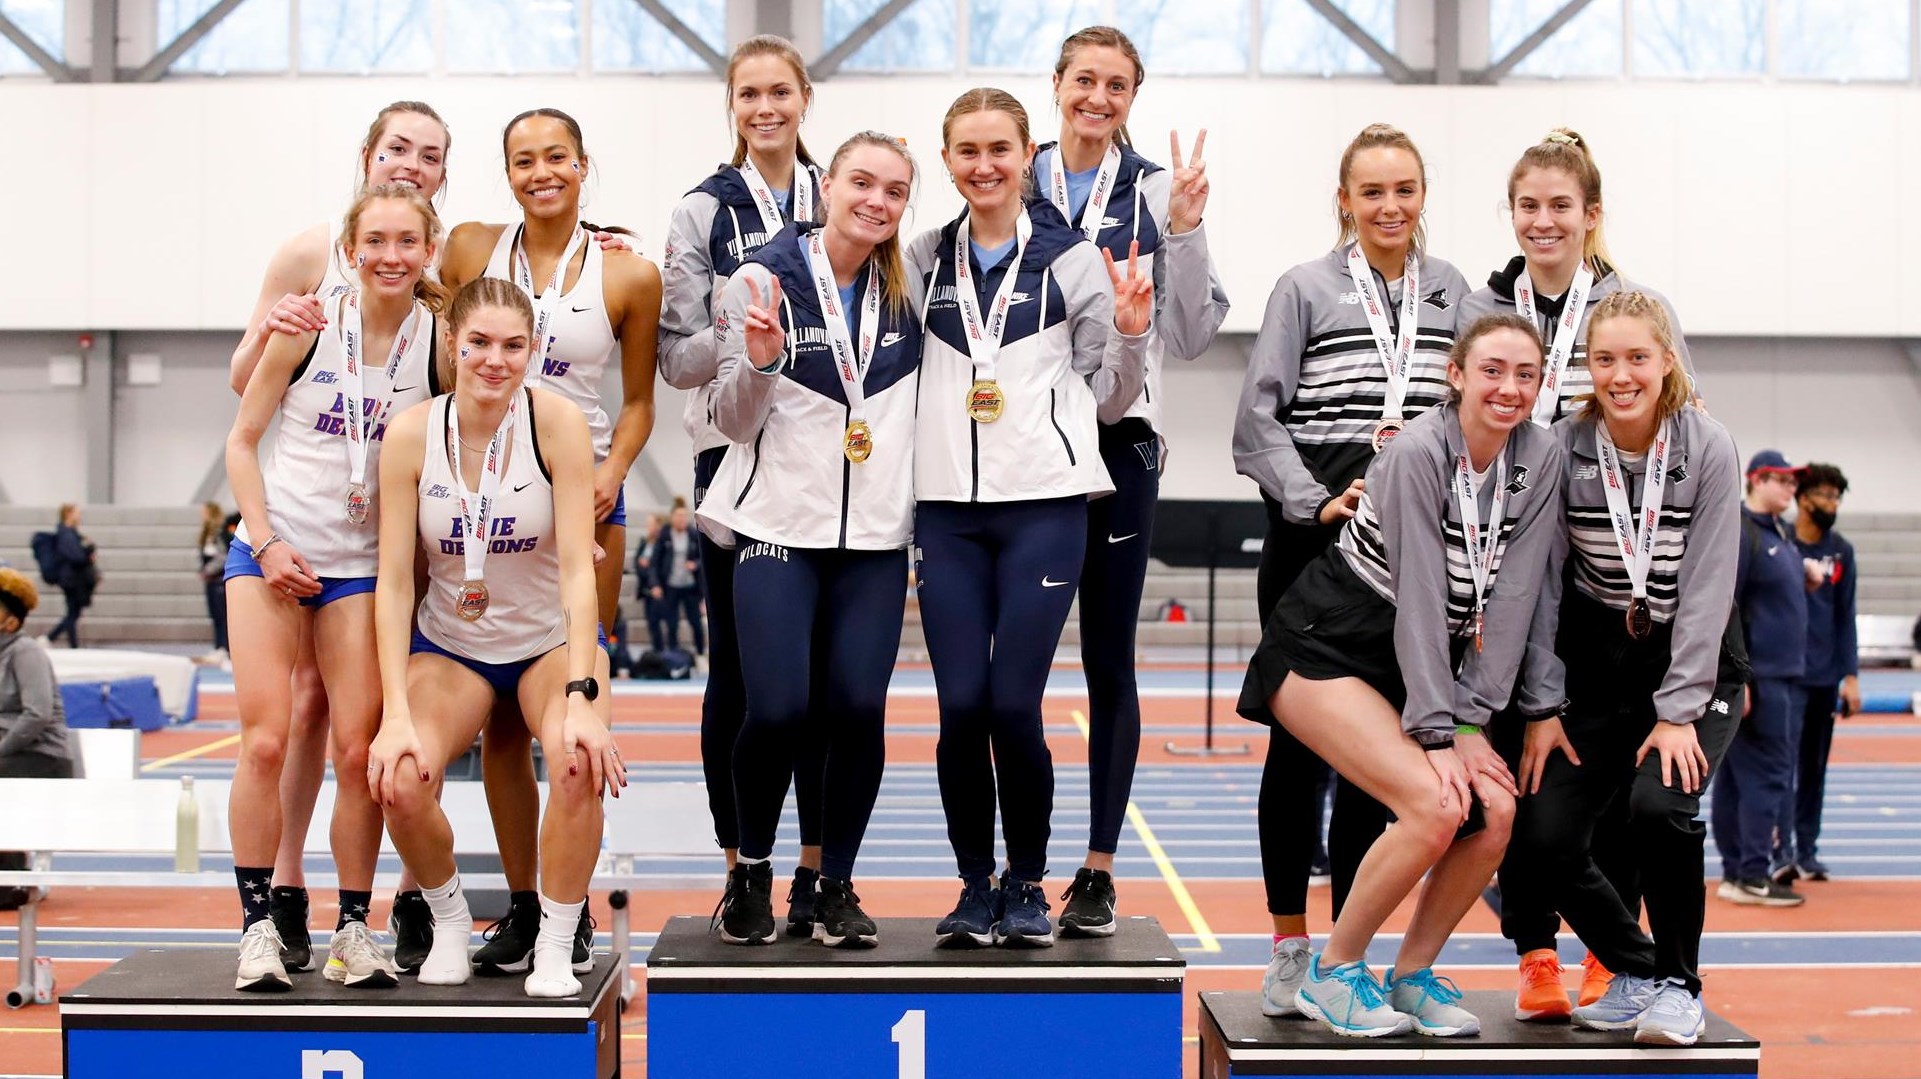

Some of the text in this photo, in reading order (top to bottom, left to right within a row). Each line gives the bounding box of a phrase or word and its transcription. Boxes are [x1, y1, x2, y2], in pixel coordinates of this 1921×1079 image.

[739, 543, 788, 564] WILDCATS
[462, 599, 486, 607] EAST
[891, 1009, 925, 1079] 1
